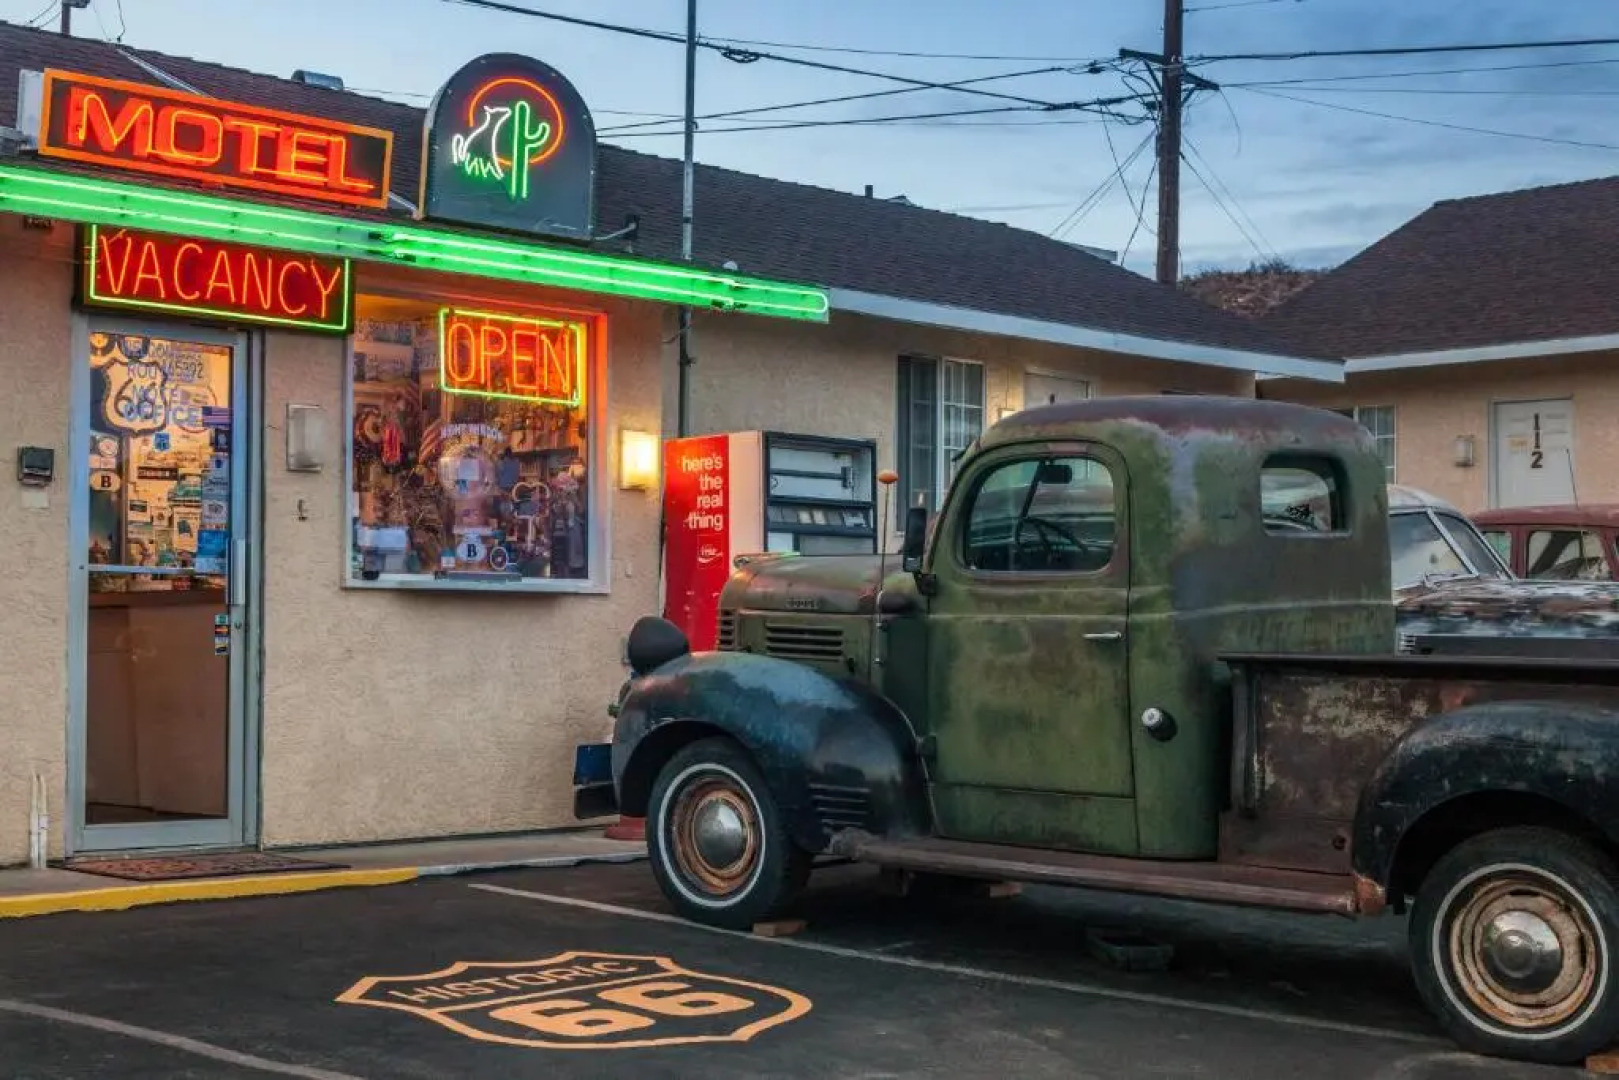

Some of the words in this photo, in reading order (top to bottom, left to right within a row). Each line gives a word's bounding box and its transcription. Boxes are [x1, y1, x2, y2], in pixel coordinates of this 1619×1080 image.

[66, 86, 375, 190] MOTEL
[100, 229, 341, 318] VACANCY
[448, 322, 571, 393] OPEN
[682, 453, 723, 473] here's
[1530, 412, 1544, 469] 112
[696, 491, 723, 509] real
[699, 472, 723, 491] the
[686, 510, 723, 531] thing
[389, 961, 638, 1004] HISTORIC
[487, 982, 756, 1037] 66
